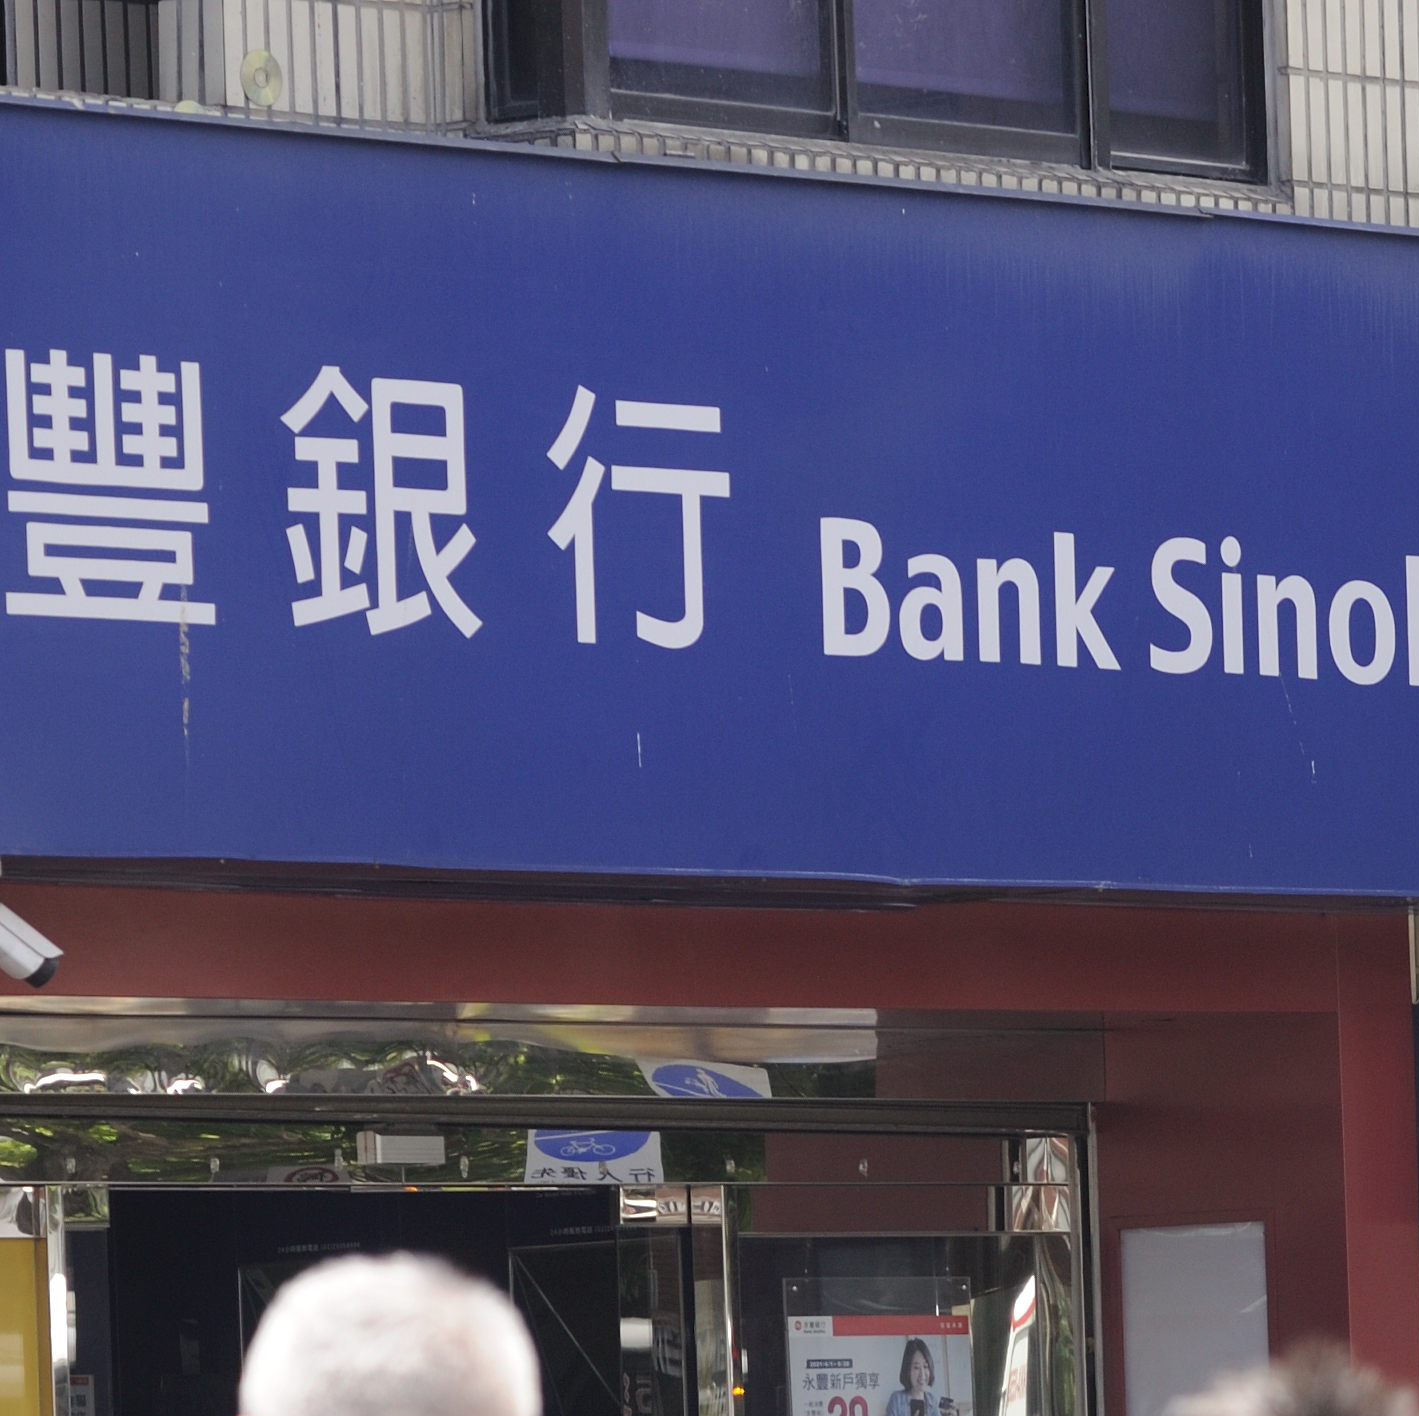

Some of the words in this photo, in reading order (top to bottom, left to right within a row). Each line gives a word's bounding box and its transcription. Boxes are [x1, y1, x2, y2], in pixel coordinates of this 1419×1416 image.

[4, 347, 730, 650] 豐銀行
[819, 516, 1122, 671] Bank
[802, 1372, 880, 1391] 永豐新戶獨享
